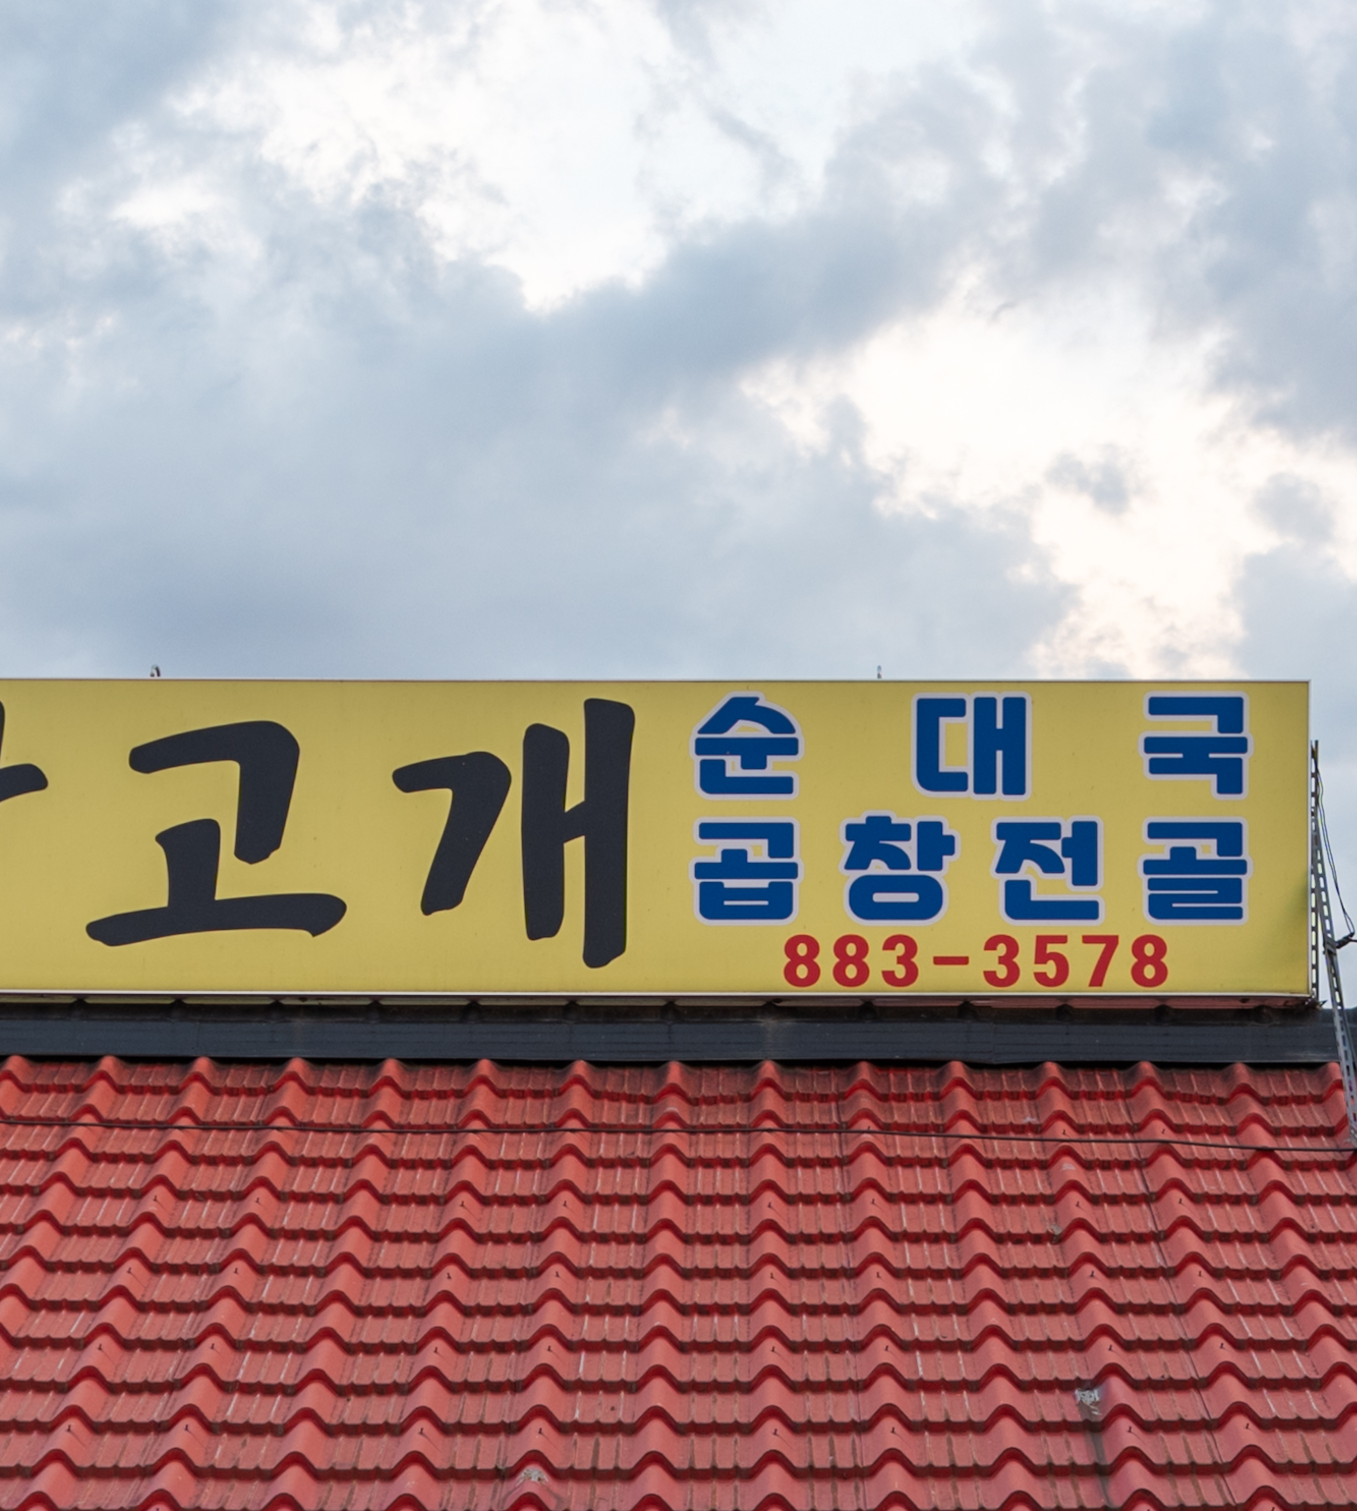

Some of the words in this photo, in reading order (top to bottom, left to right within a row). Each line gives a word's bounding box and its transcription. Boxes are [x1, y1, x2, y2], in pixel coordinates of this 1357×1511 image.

[691, 689, 1253, 801] 순대국
[693, 815, 1251, 924] 곱창전골
[783, 933, 1171, 991] 883-3578
